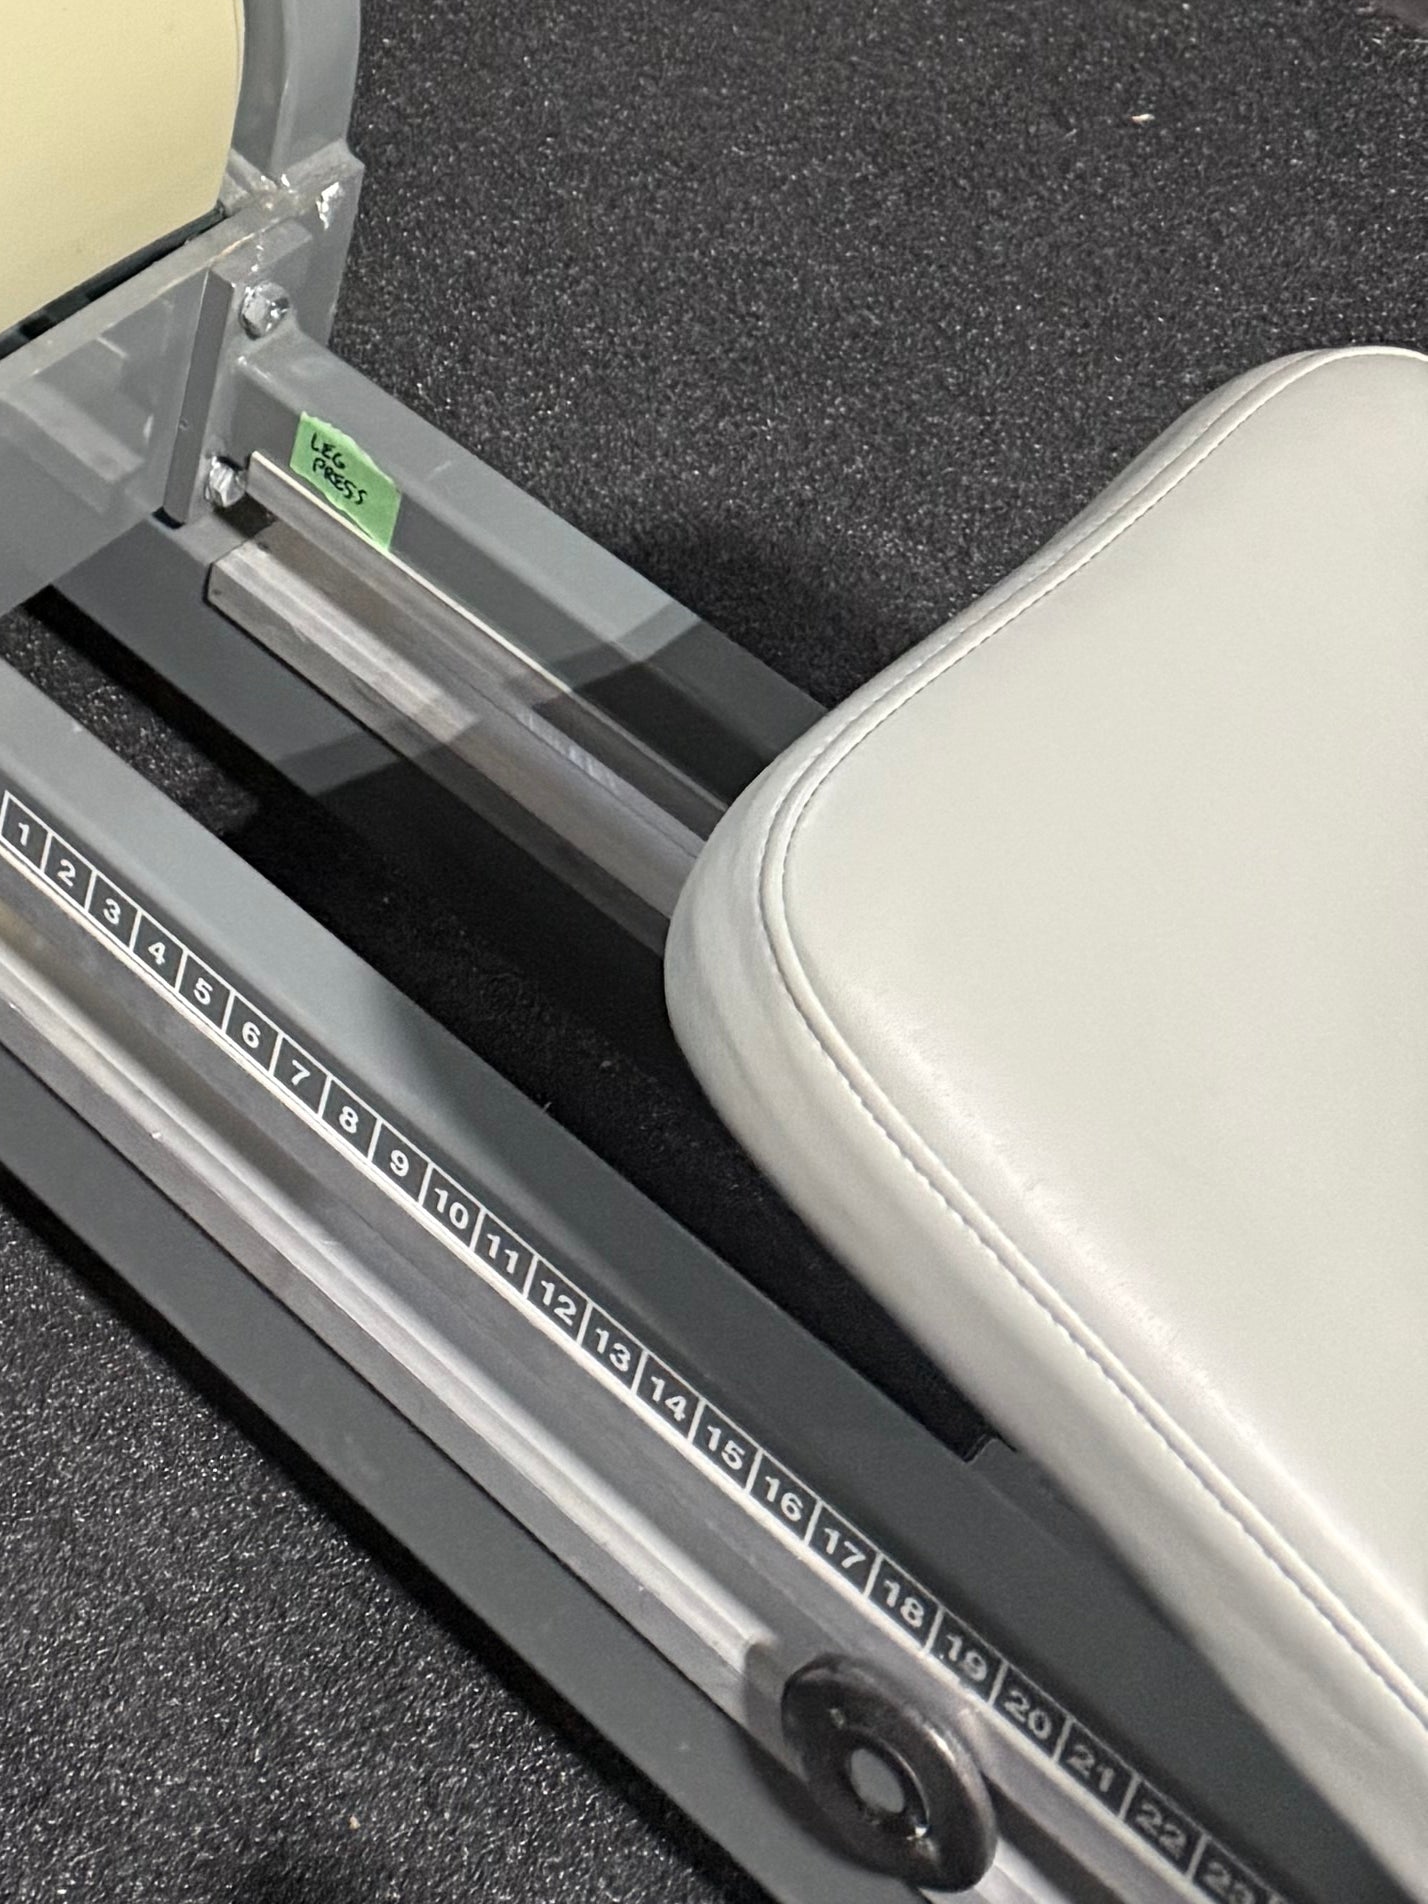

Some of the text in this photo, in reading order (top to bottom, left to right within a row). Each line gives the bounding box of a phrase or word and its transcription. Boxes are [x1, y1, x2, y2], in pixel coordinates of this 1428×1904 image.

[310, 432, 346, 470] LEG
[312, 456, 368, 506] PRESS
[18, 823, 30, 847] 1
[57, 859, 76, 887] 2
[103, 898, 121, 925] 3
[148, 941, 166, 965] 4
[194, 977, 213, 1006] 5
[242, 1021, 261, 1049] 6
[291, 1060, 310, 1086] 7
[339, 1104, 360, 1134] 8
[389, 1149, 409, 1177] 9
[434, 1187, 470, 1230] 10
[487, 1233, 519, 1274] 11
[540, 1279, 577, 1327] 12
[595, 1326, 631, 1373] 13
[650, 1374, 686, 1422] 14
[706, 1423, 746, 1469] 15
[764, 1475, 802, 1523] 16
[824, 1526, 866, 1569] 17
[883, 1579, 924, 1627] 18
[946, 1635, 988, 1683] 19
[1004, 1690, 1054, 1739] 20
[1067, 1744, 1114, 1793] 21
[1138, 1803, 1188, 1855] 22
